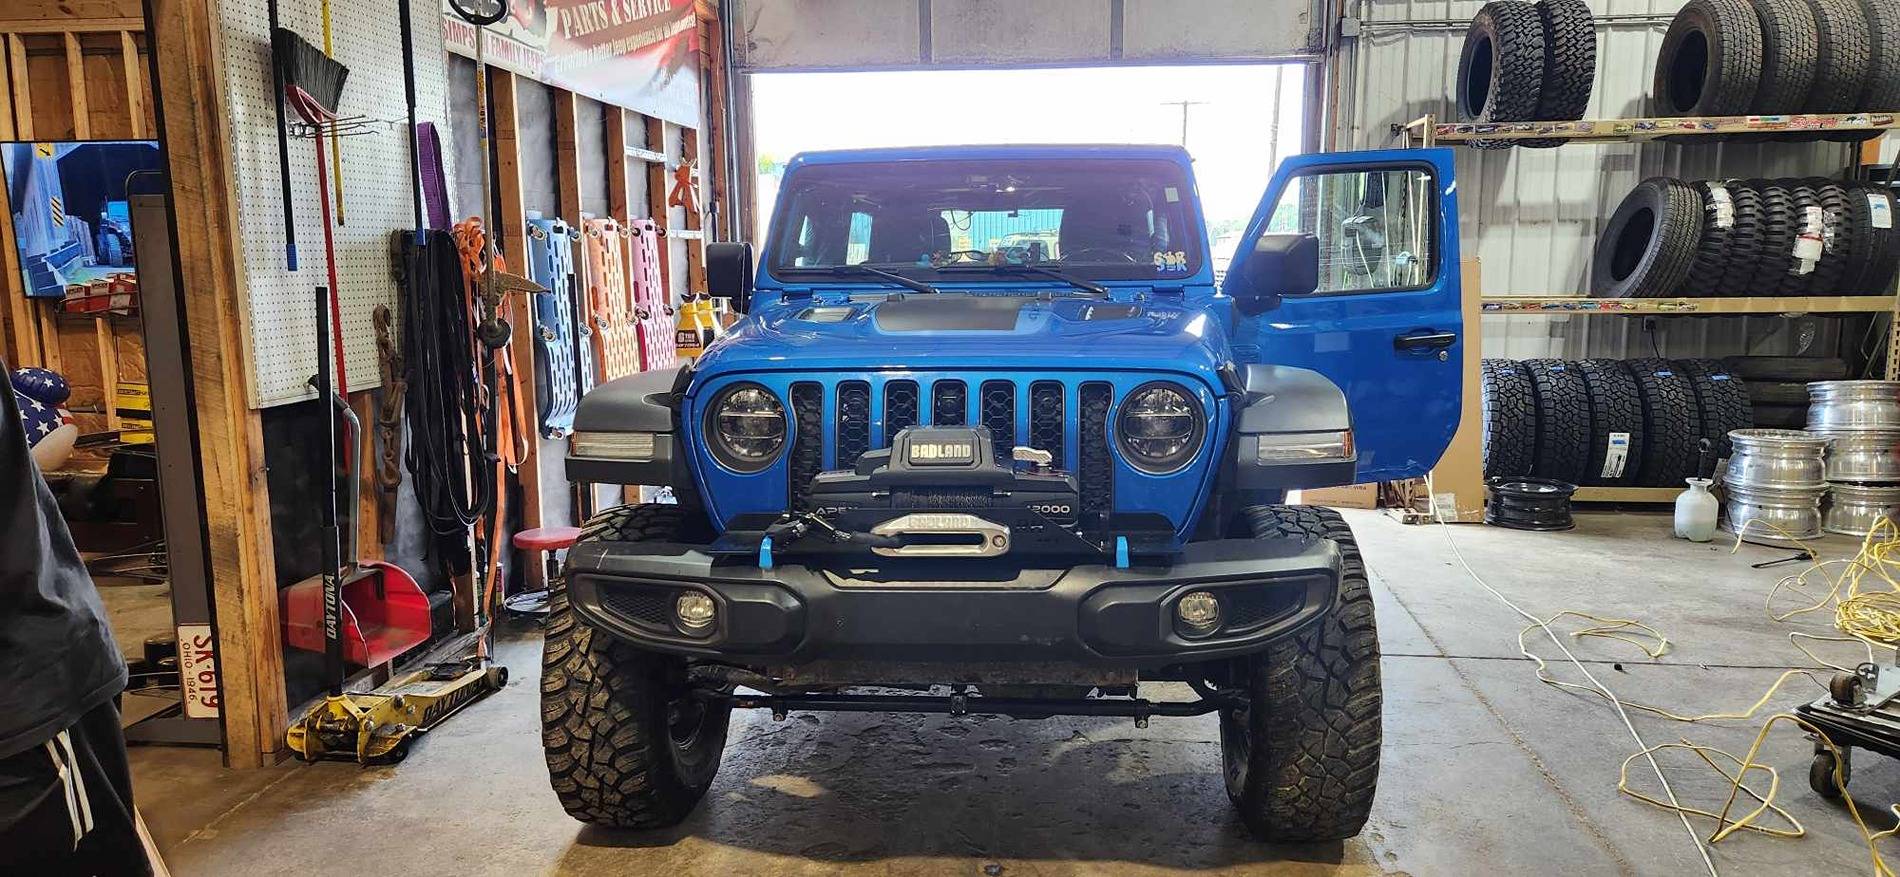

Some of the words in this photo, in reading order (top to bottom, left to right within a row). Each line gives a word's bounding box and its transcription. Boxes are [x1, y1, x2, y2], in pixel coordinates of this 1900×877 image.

[561, 2, 609, 39] PARTS
[611, 0, 622, 26] &
[623, 0, 671, 23] SERVICE
[911, 443, 970, 459] BADLAND
[815, 506, 858, 515] APE
[1026, 505, 1071, 514] 2000
[324, 574, 337, 640] DAYTONA
[182, 642, 193, 669] OHIO
